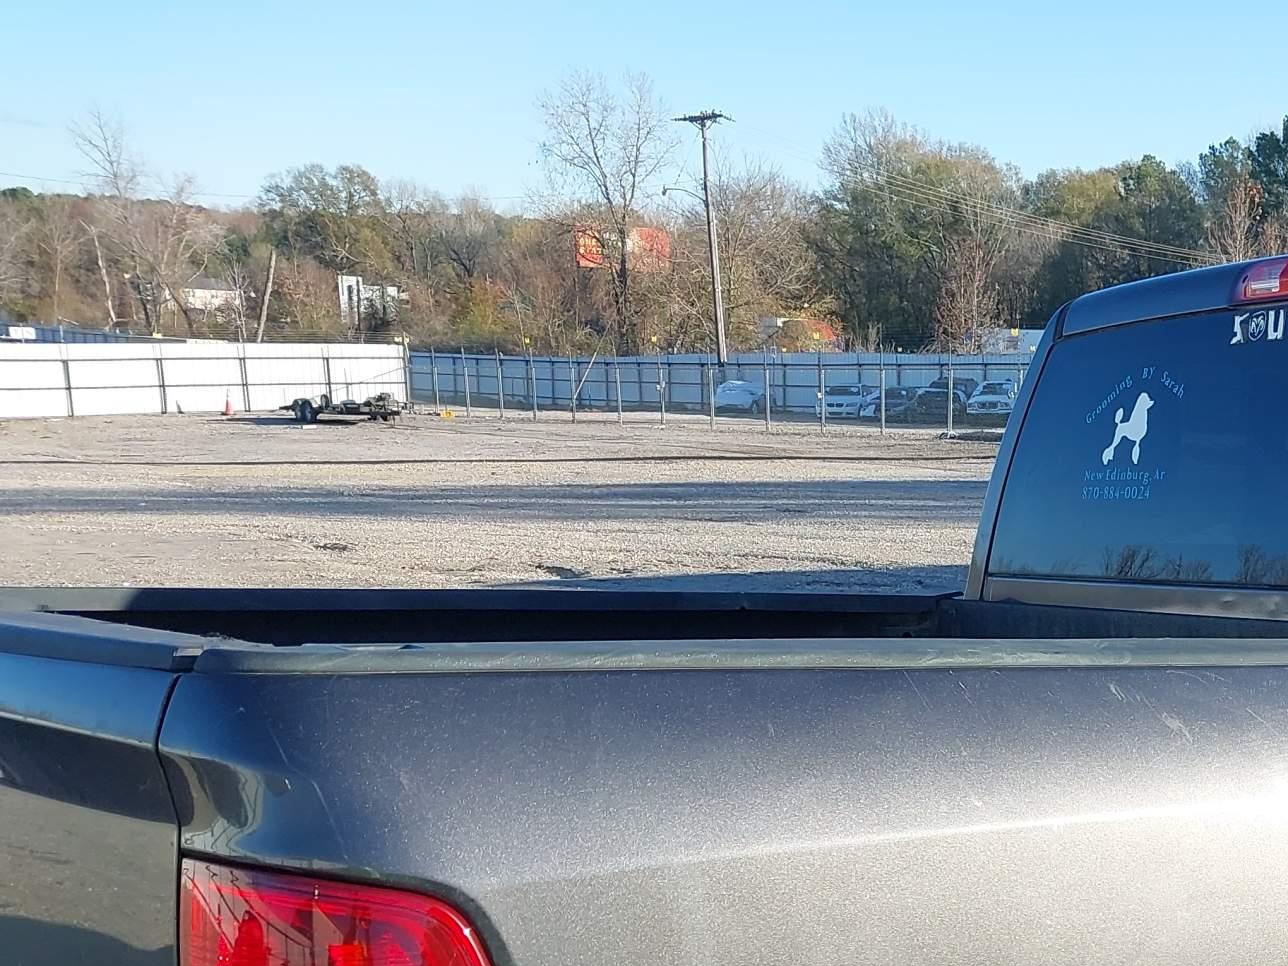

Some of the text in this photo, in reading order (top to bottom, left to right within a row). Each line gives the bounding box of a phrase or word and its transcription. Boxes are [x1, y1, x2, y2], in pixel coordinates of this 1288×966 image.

[1085, 366, 1185, 424] Grooming BY Sarah
[1084, 469, 1104, 481] New
